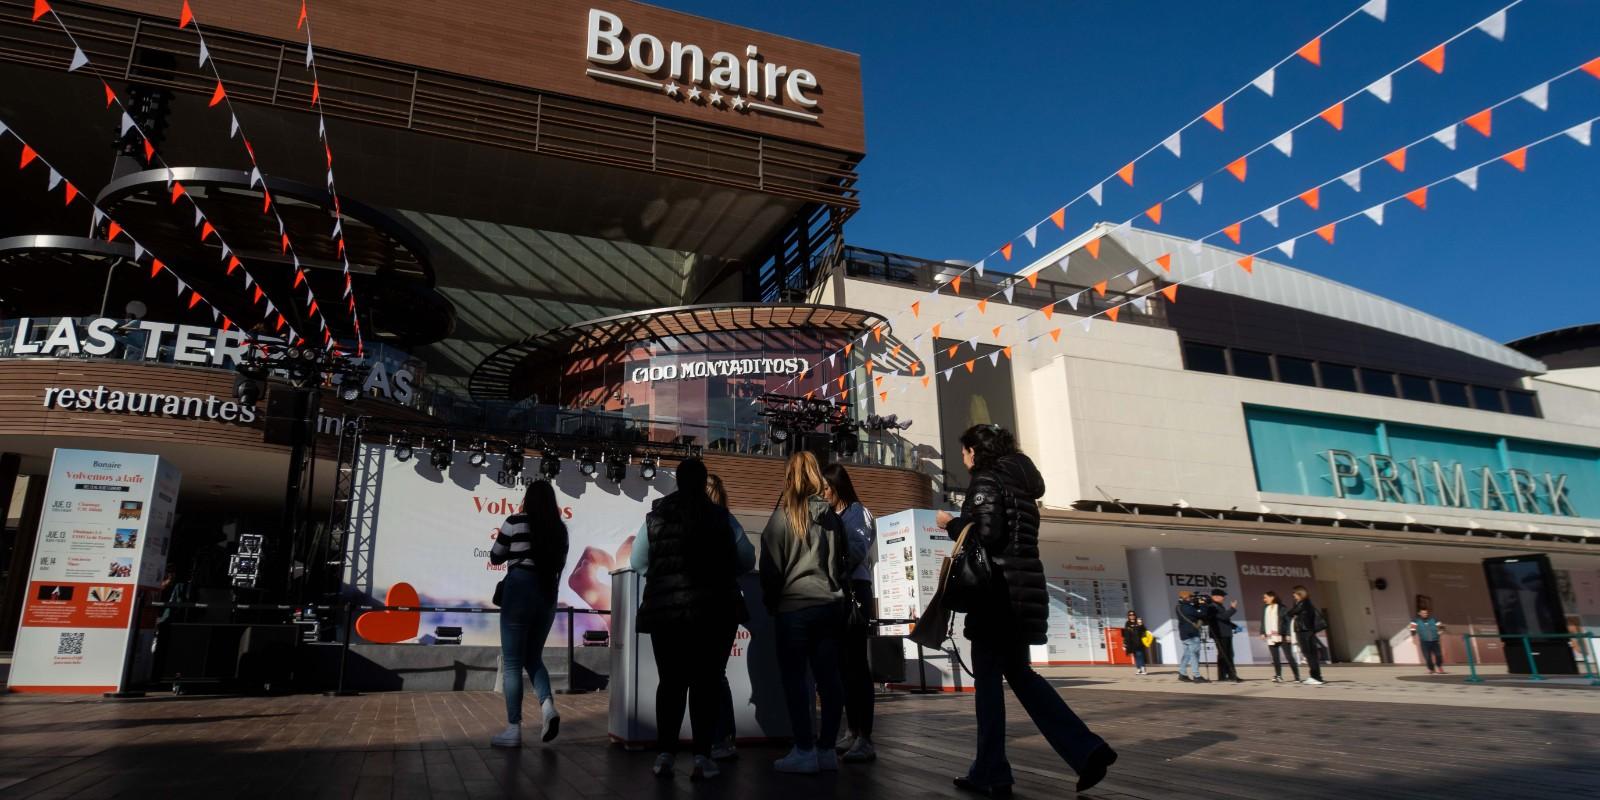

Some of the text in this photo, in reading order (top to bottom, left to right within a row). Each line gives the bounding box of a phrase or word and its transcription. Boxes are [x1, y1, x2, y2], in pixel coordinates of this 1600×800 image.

[587, 8, 818, 108] Bonaire
[13, 317, 119, 355] LAS
[43, 384, 256, 423] restaurantes
[66, 472, 113, 481] Volvemos
[93, 460, 122, 468] Bonaire
[1327, 448, 1580, 518] PRIMARK
[1241, 564, 1312, 578] CALZEDONIA
